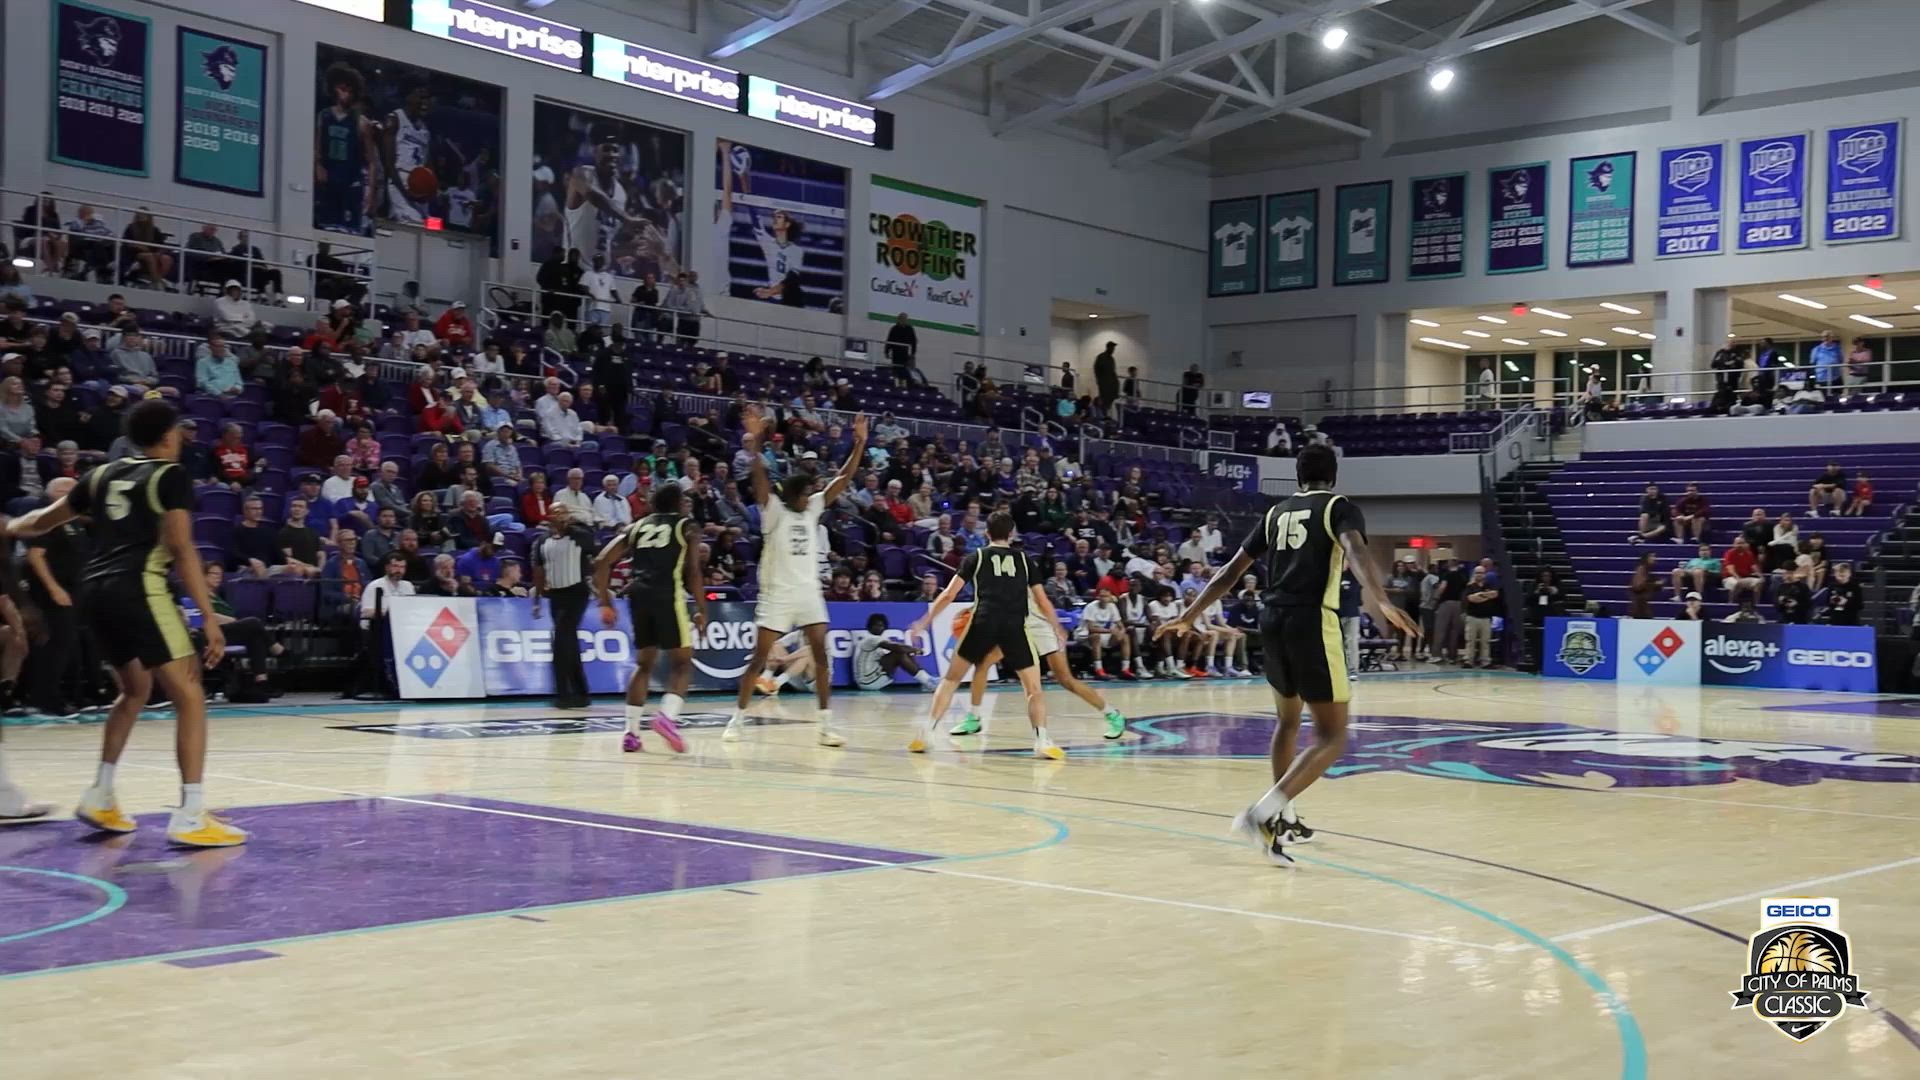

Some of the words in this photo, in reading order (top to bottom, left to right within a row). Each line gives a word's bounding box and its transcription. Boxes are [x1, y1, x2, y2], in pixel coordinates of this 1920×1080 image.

[184, 120, 220, 137] 2018
[223, 128, 259, 145] 2019
[184, 135, 220, 152] 2020
[869, 212, 977, 257] CROWTHER
[1746, 225, 1794, 243] 2021
[1832, 214, 1887, 234] 2022
[1666, 236, 1711, 253] 2017
[876, 241, 966, 280] ROOFING
[105, 480, 136, 520] 5
[636, 524, 672, 549] 23
[1276, 509, 1312, 551] 15
[991, 554, 1016, 577] 14
[486, 630, 629, 663] GECO
[1704, 634, 1780, 658] alexa+
[1787, 649, 1873, 668] GEICO
